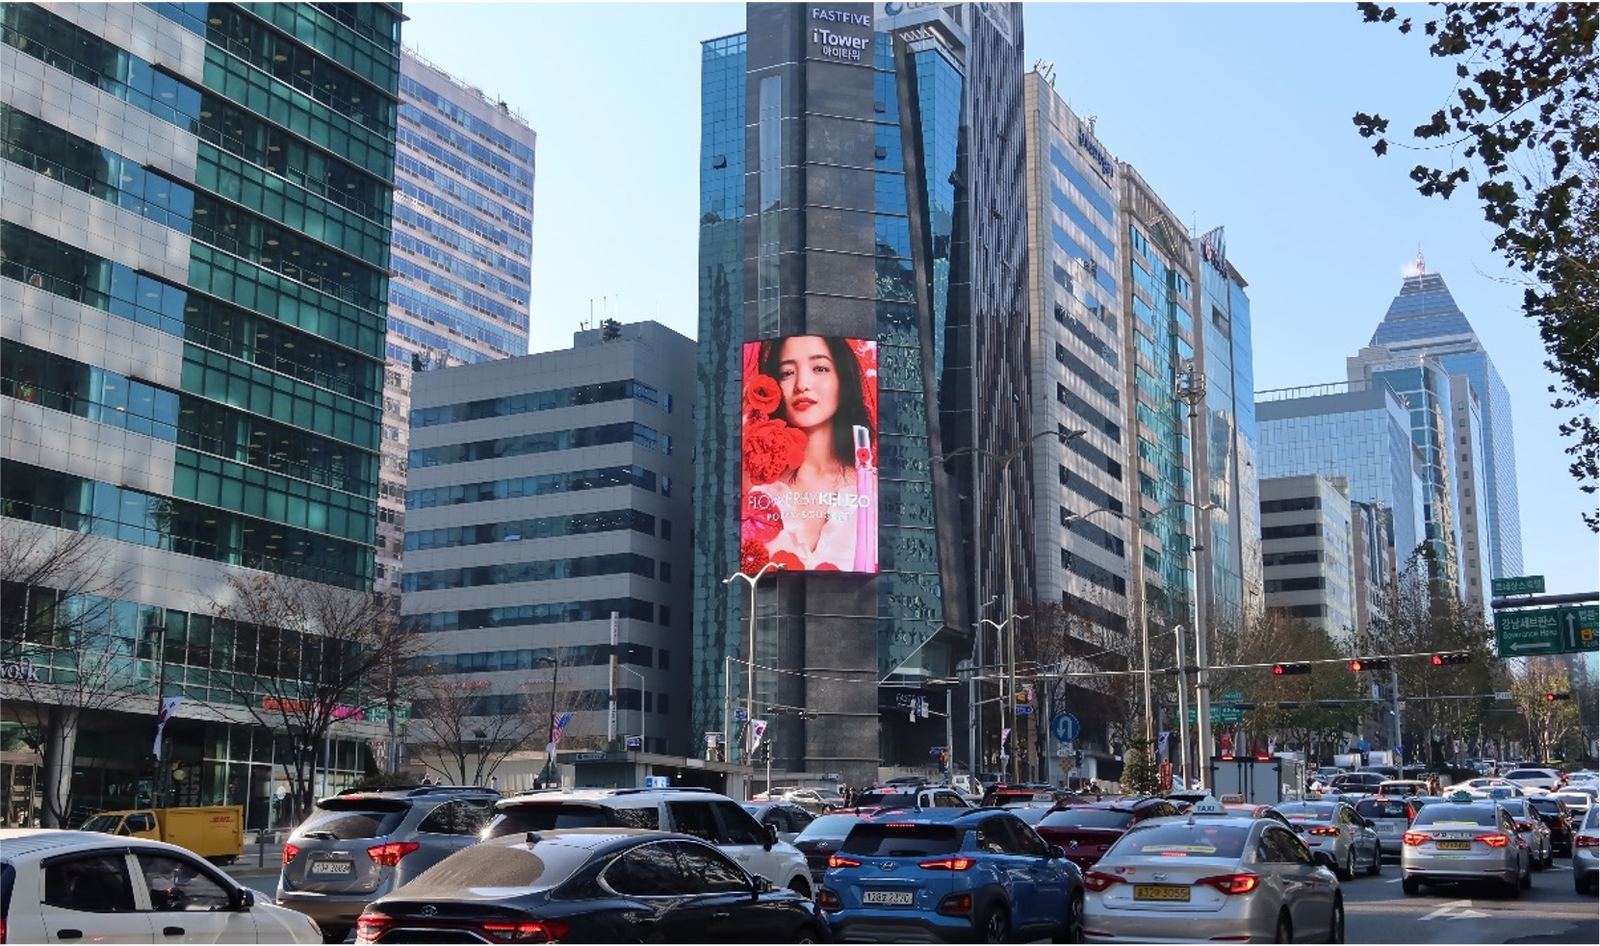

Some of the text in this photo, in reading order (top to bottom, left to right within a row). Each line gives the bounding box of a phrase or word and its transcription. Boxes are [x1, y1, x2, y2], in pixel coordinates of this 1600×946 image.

[812, 8, 871, 27] FASTFIVE
[823, 46, 861, 61] 아이타워
[1502, 615, 1558, 630] 강남세브란스
